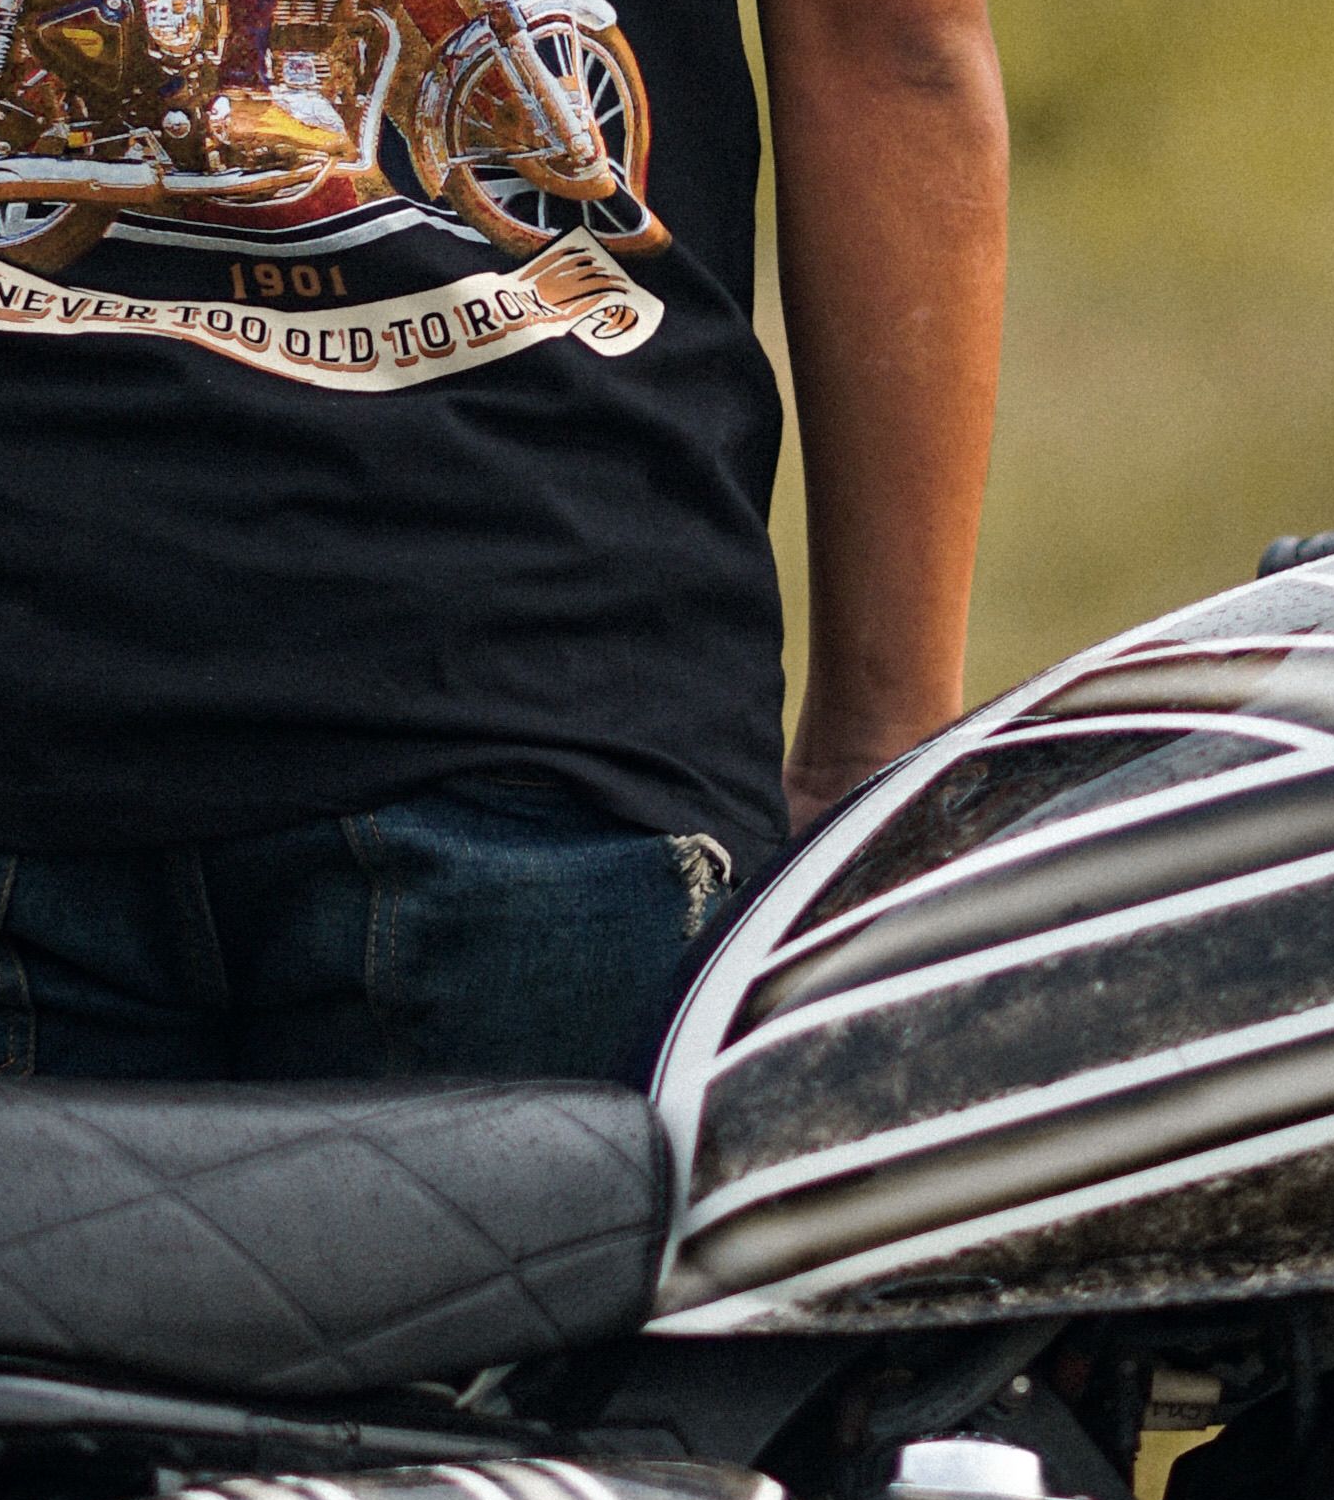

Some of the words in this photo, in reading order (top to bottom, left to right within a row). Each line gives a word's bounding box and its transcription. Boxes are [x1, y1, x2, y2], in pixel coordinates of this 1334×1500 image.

[229, 261, 348, 300] 1901
[173, 305, 269, 348] TOO
[284, 327, 376, 367] OLD
[385, 311, 453, 361] TO
